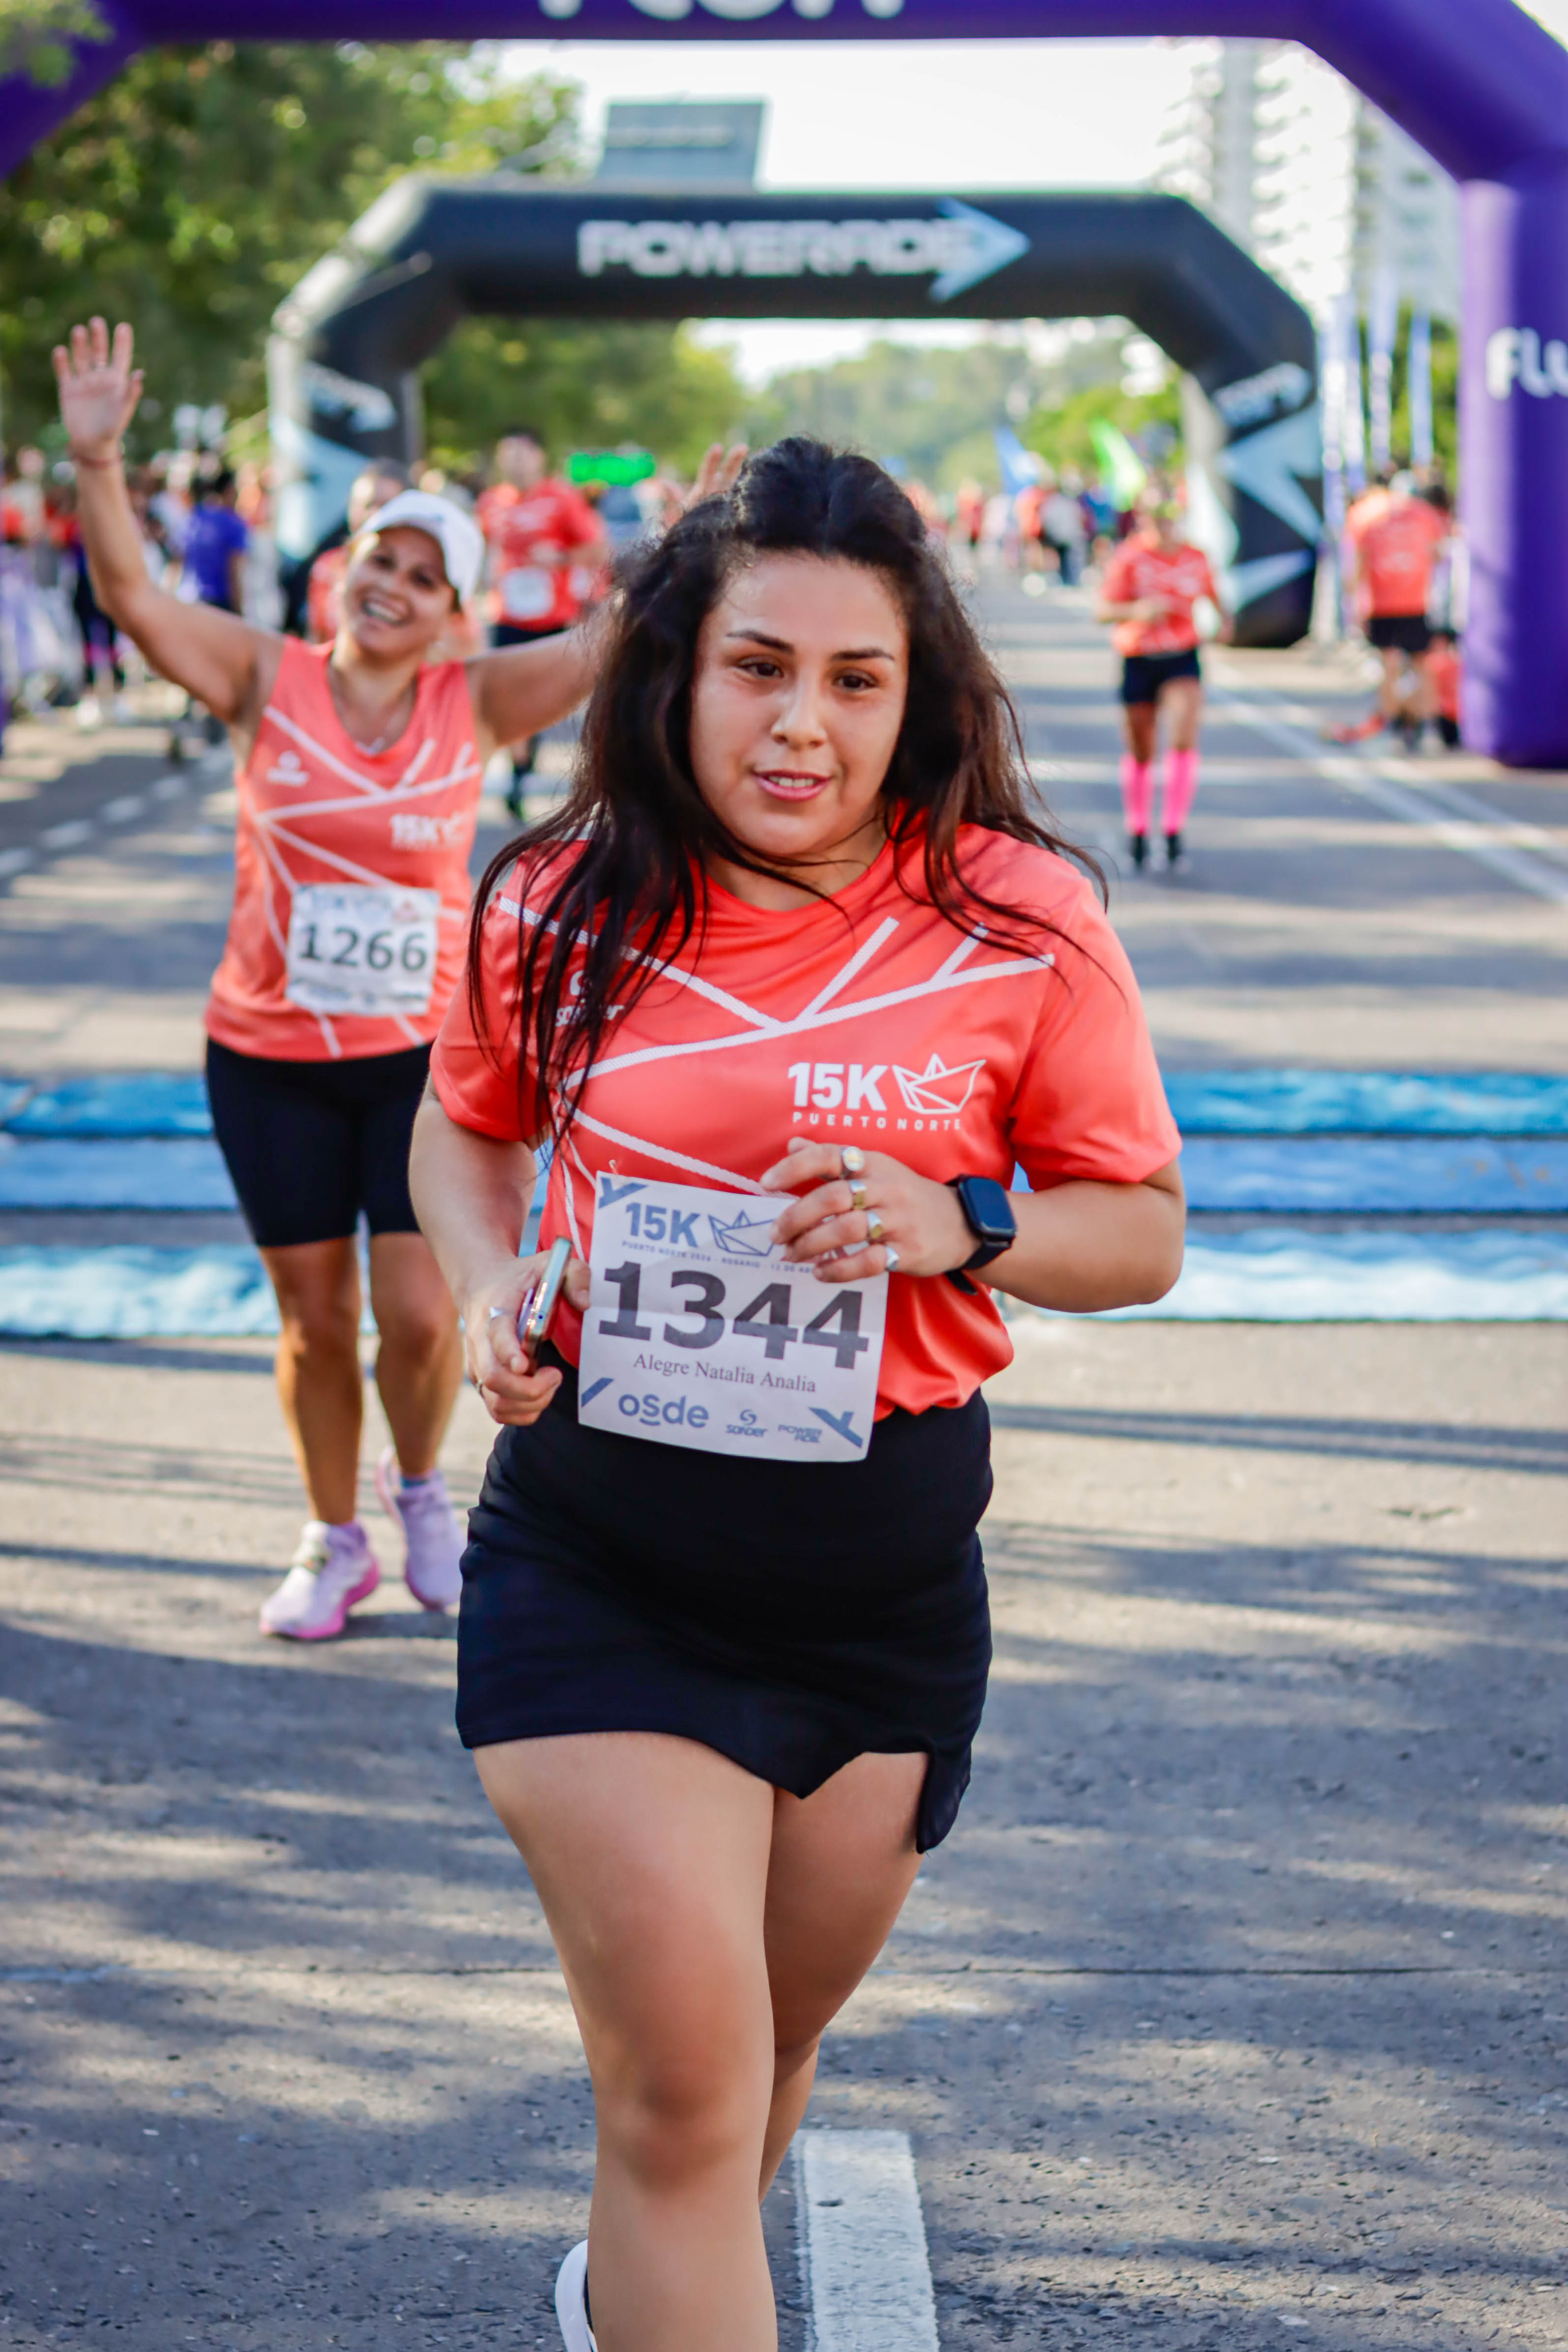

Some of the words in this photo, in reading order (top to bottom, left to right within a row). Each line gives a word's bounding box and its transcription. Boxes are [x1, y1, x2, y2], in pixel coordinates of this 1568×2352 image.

[298, 922, 427, 971] 1266
[788, 1062, 889, 1111] 15K
[792, 1112, 887, 1129] PUERTO
[897, 1118, 961, 1130] NORTE
[625, 1202, 701, 1248] 15K
[621, 1240, 655, 1253] PUERTO
[598, 1261, 869, 1370] 1344
[633, 1353, 689, 1377] Alegre
[694, 1361, 754, 1384] Natalia
[618, 1395, 709, 1428] osde
